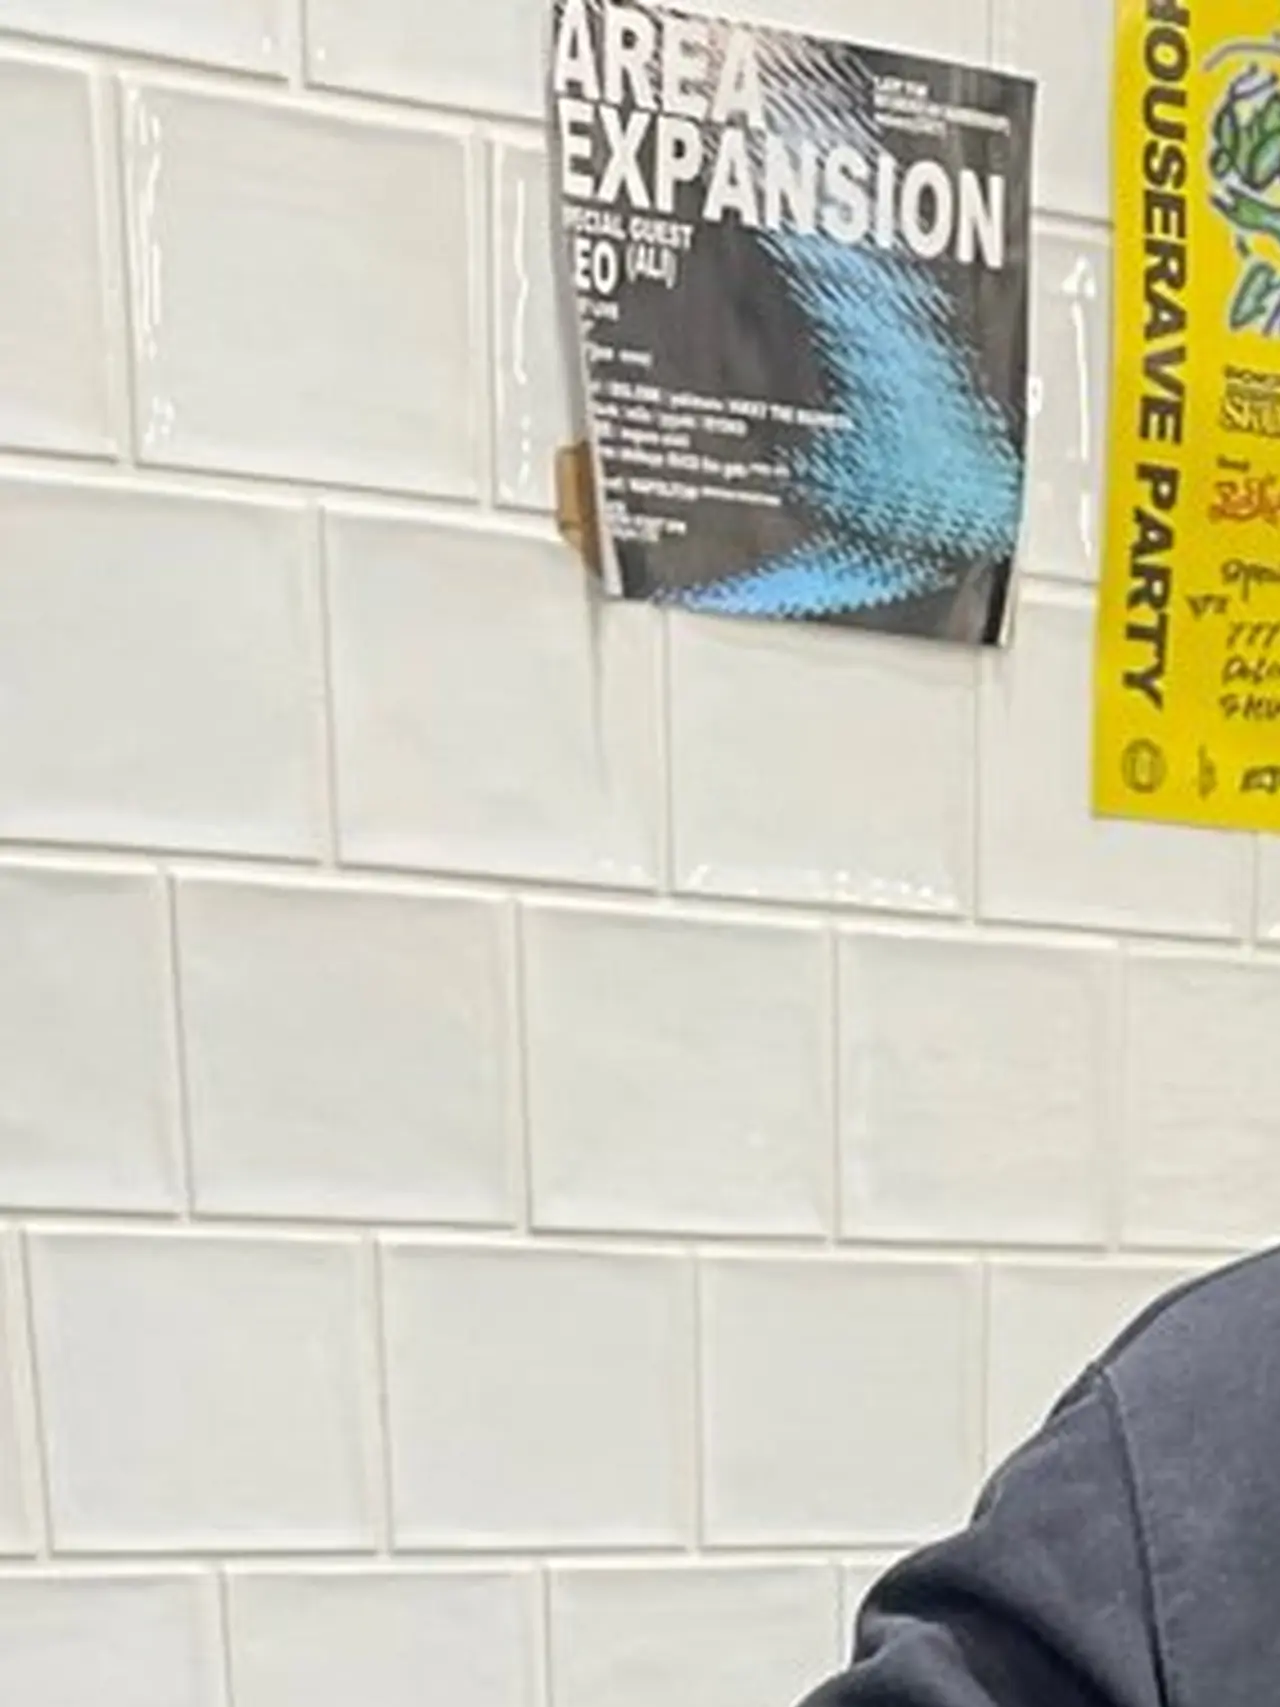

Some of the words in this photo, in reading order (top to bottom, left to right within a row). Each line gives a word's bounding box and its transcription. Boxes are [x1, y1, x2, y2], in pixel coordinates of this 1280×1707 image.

[554, 0, 765, 128] AREA
[557, 98, 1006, 269] EXPANSION
[629, 217, 694, 250] GUEST
[1122, 461, 1182, 712] PARTY
